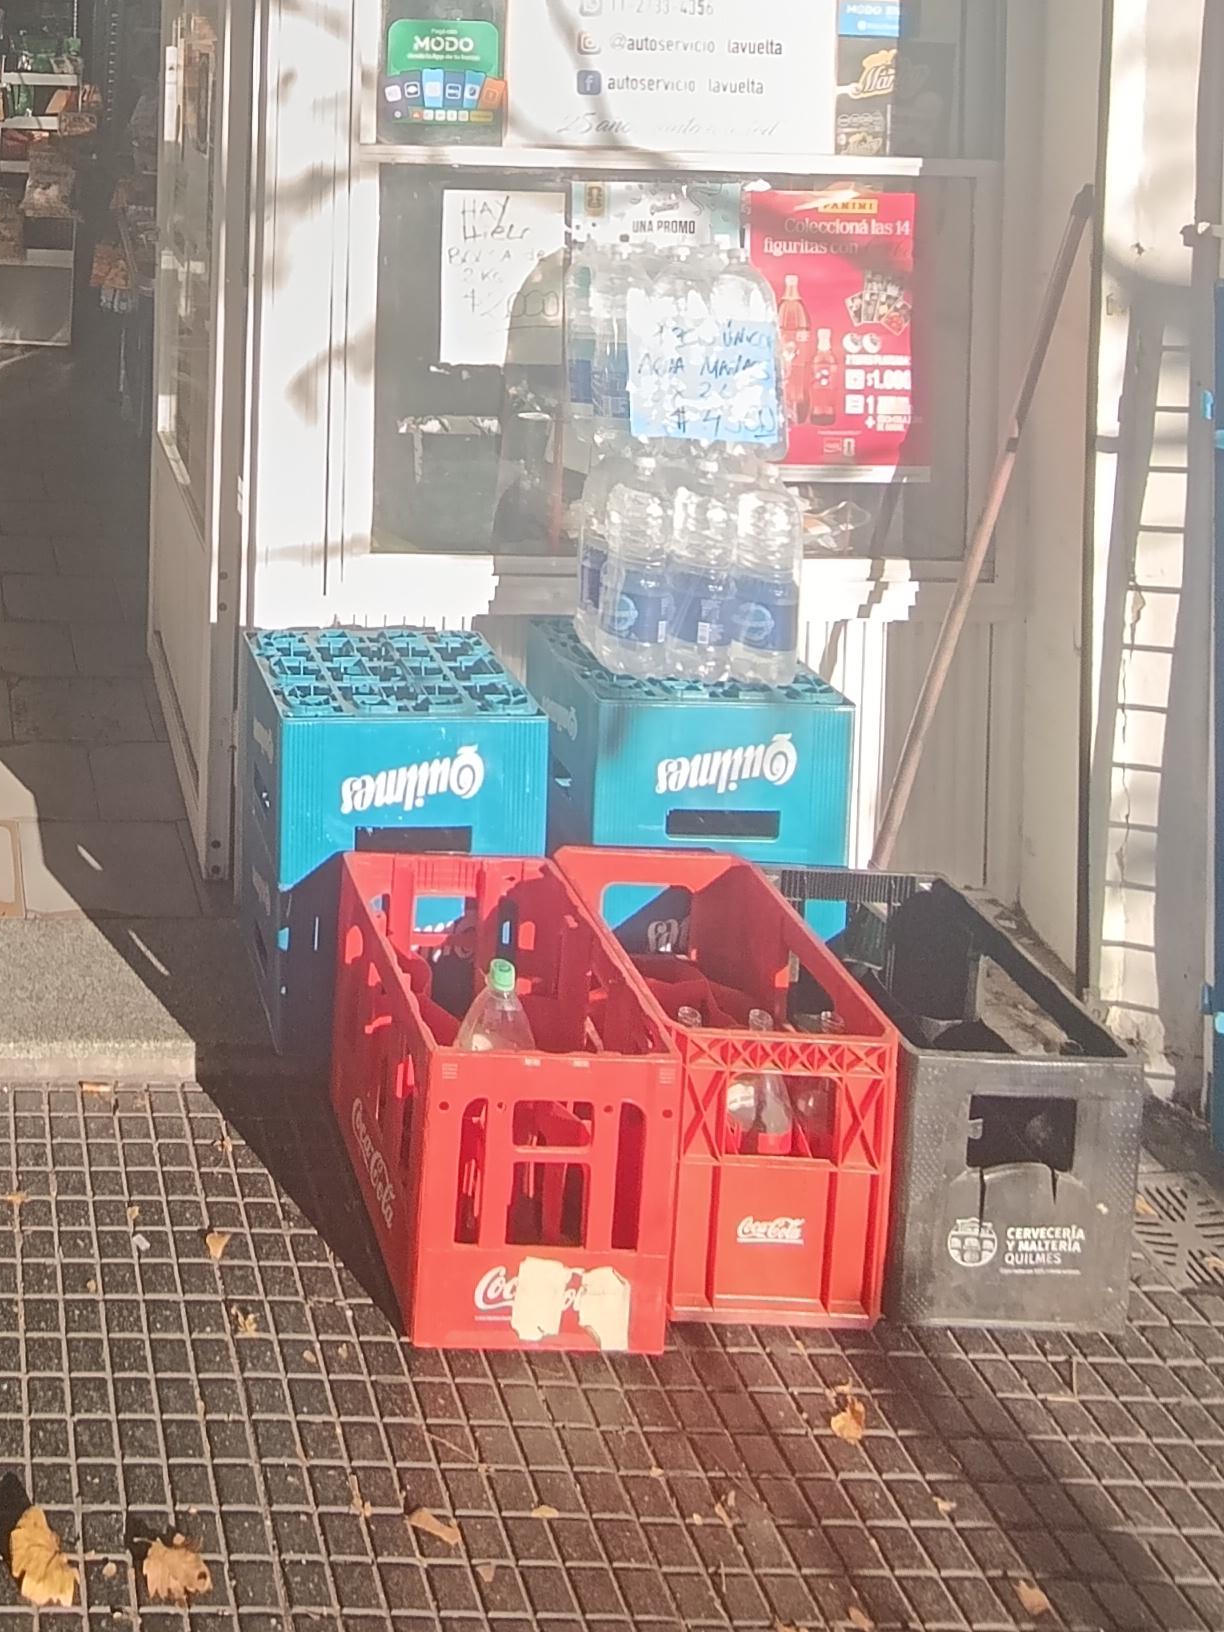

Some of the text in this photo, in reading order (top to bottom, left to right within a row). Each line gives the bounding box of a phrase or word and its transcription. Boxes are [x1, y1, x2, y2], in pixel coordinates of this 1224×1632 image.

[413, 35, 474, 52] MODO
[462, 195, 510, 227] HAY
[632, 220, 695, 235] UNA PROMO
[784, 218, 910, 235] Coleccioná las 14
[763, 237, 827, 256] figuritas
[829, 241, 858, 255] con
[655, 732, 799, 795] Quilmes
[340, 743, 485, 814] Quilmes
[736, 1215, 804, 1245] Coca-Cola
[1005, 1224, 1086, 1240] CERVECERÍA
[1005, 1239, 1015, 1252] Y
[1004, 1252, 1063, 1266] QUILMES
